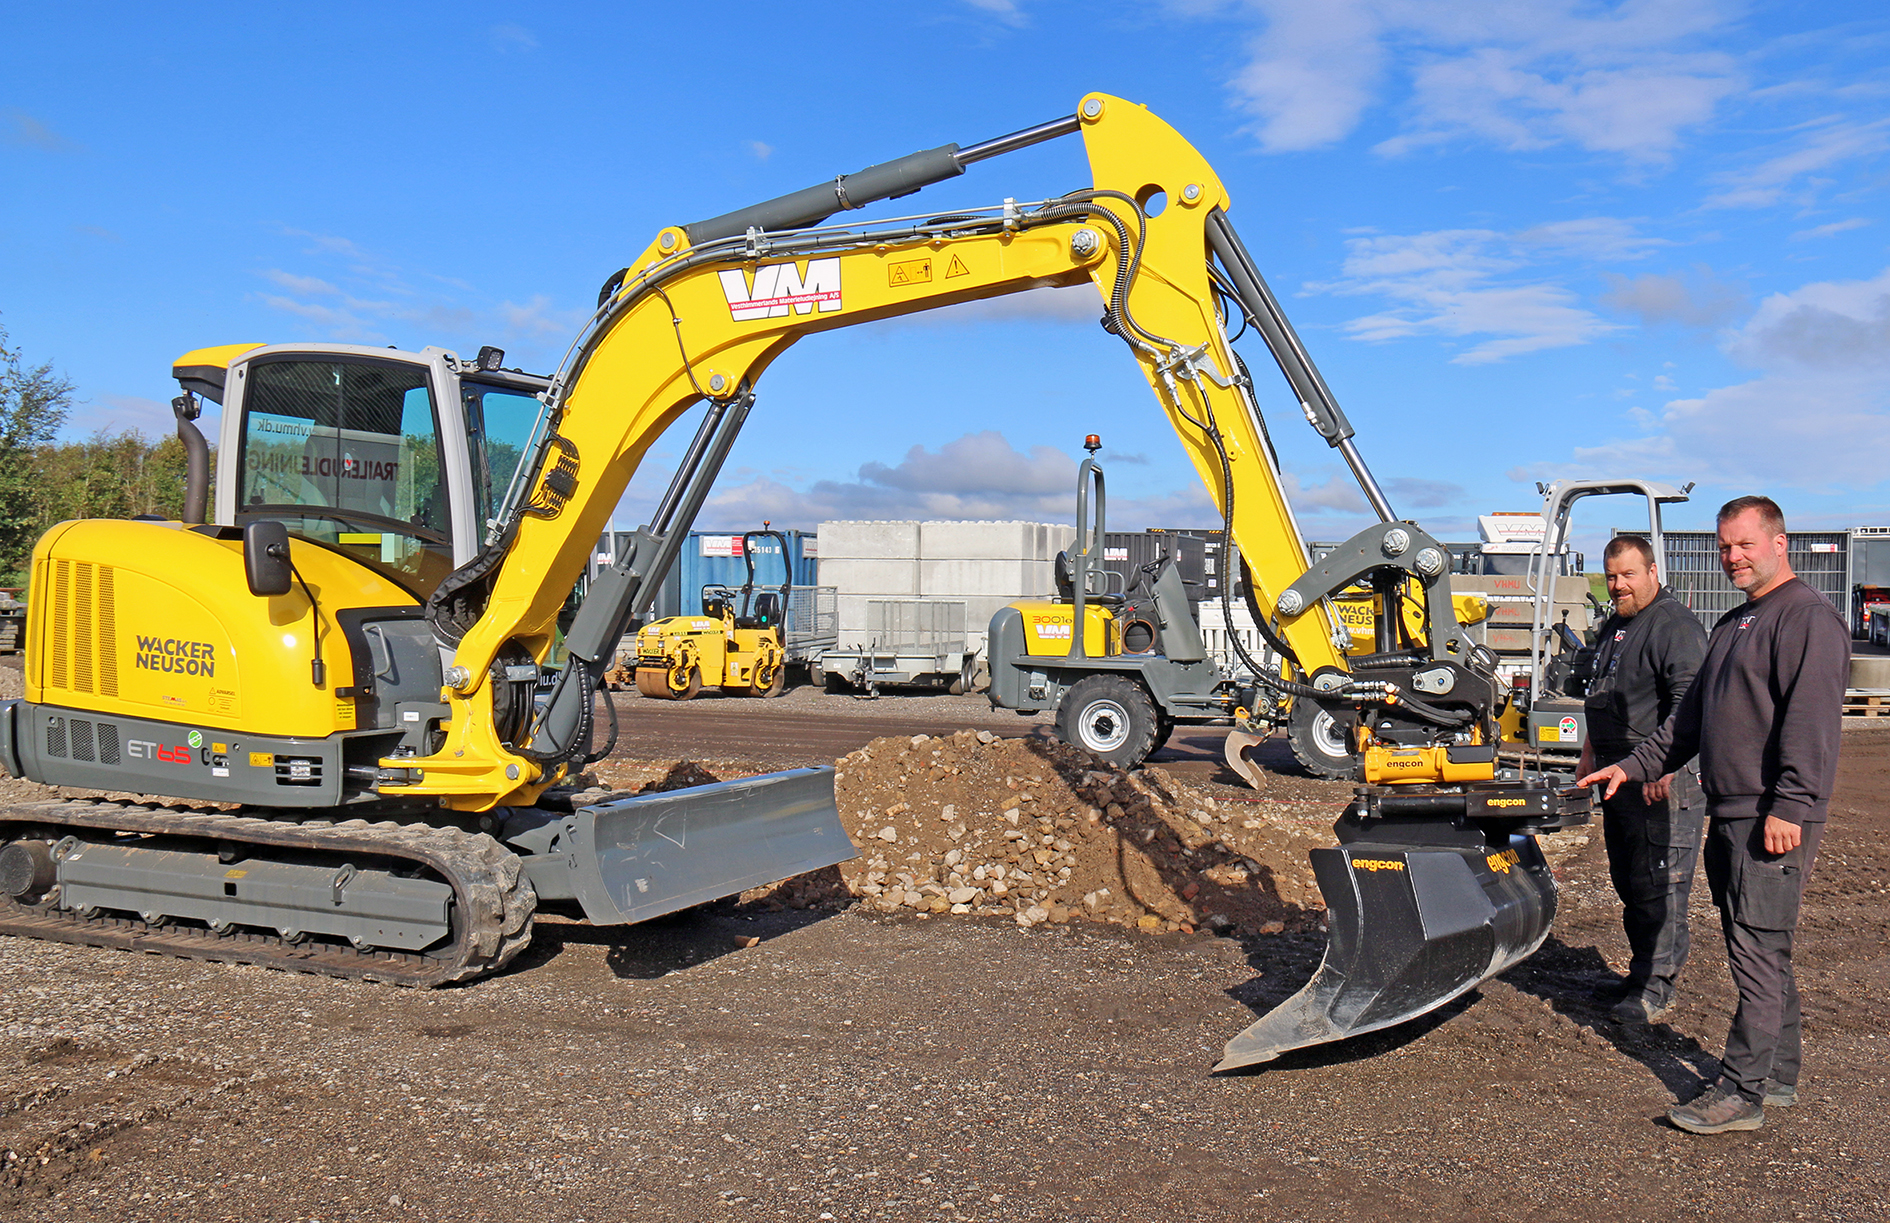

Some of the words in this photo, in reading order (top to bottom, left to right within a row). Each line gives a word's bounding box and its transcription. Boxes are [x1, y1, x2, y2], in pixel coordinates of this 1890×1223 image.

[717, 256, 842, 322] VM
[1494, 580, 1521, 589] VHMU
[1035, 624, 1071, 639] VM
[136, 635, 215, 660] WACKER
[136, 652, 215, 678] NEUSON
[127, 739, 192, 765] ET65
[1486, 798, 1526, 808] engcon
[1351, 859, 1404, 872] engcon
[1486, 848, 1521, 874] engcon
